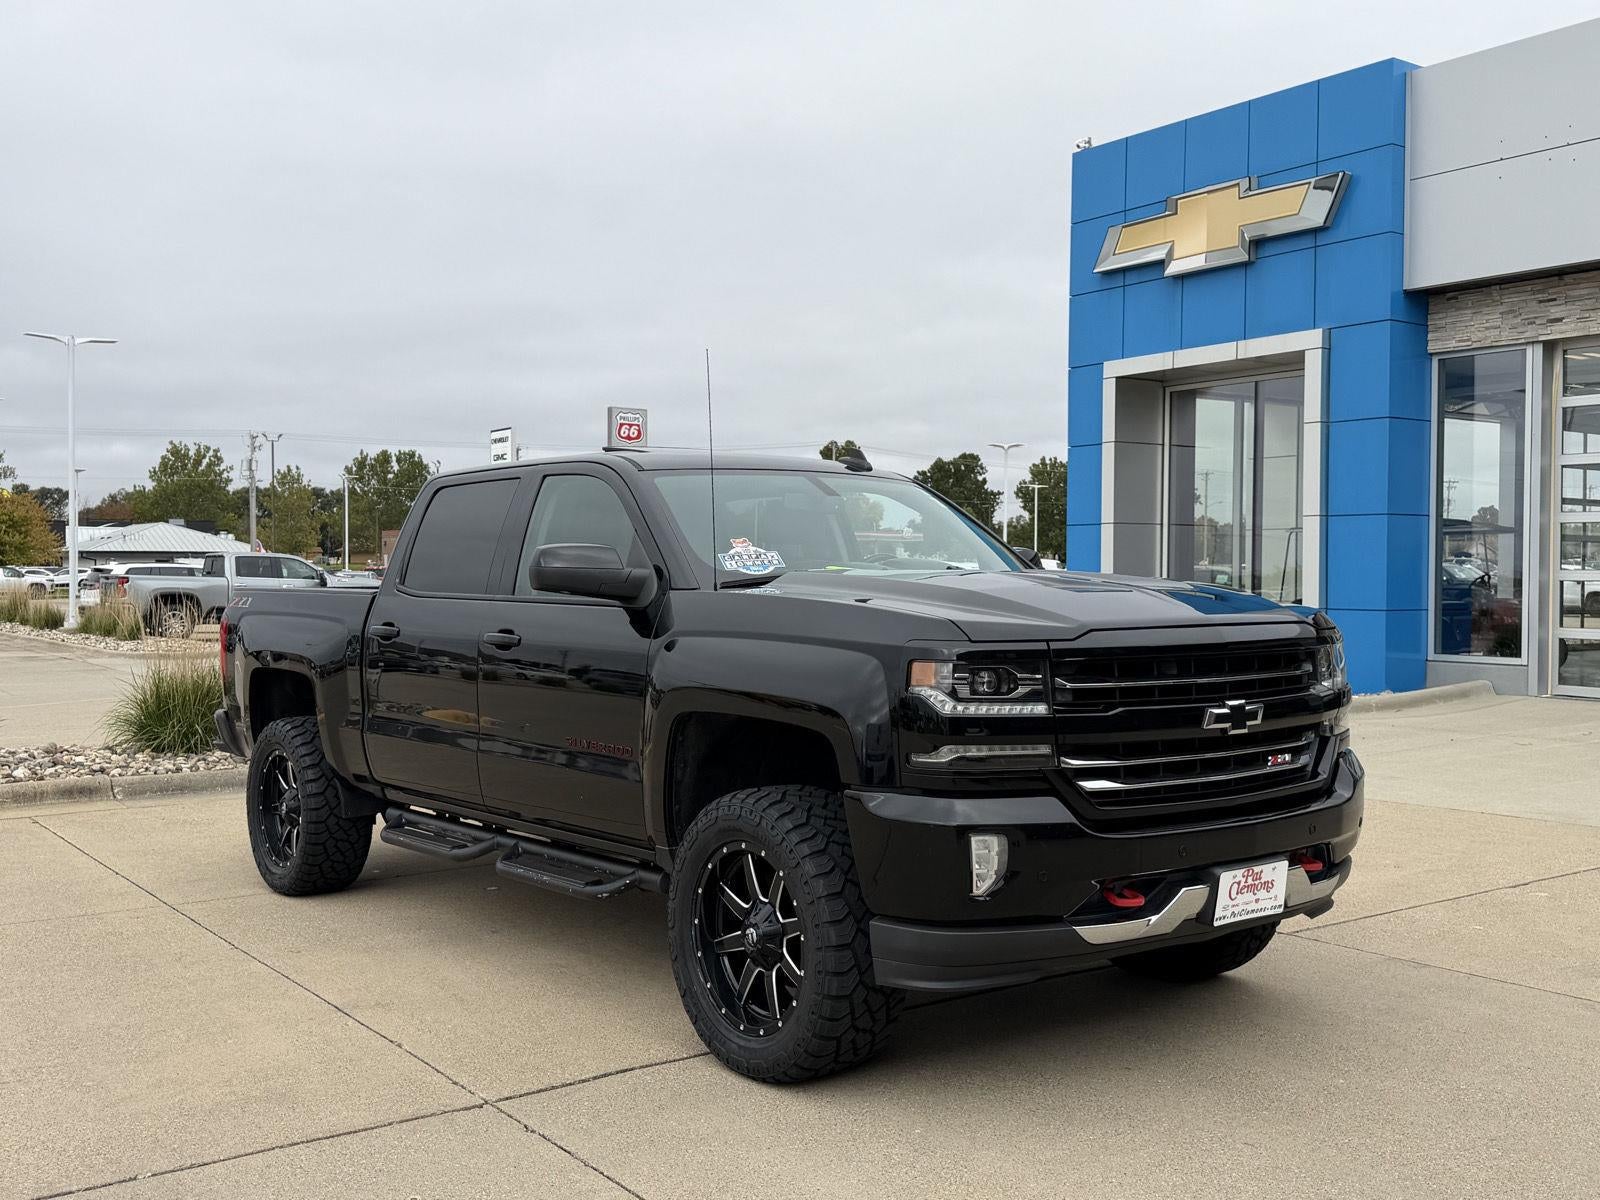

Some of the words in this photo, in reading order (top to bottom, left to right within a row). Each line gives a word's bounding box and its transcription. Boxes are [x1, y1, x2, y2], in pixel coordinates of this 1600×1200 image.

[619, 415, 640, 423] PHILLIPS
[620, 424, 639, 438] 66
[493, 453, 507, 461] GMC
[1241, 868, 1263, 884] Pat
[1228, 879, 1275, 901] Clemons
[1215, 904, 1282, 922] www.PatClemons.com
